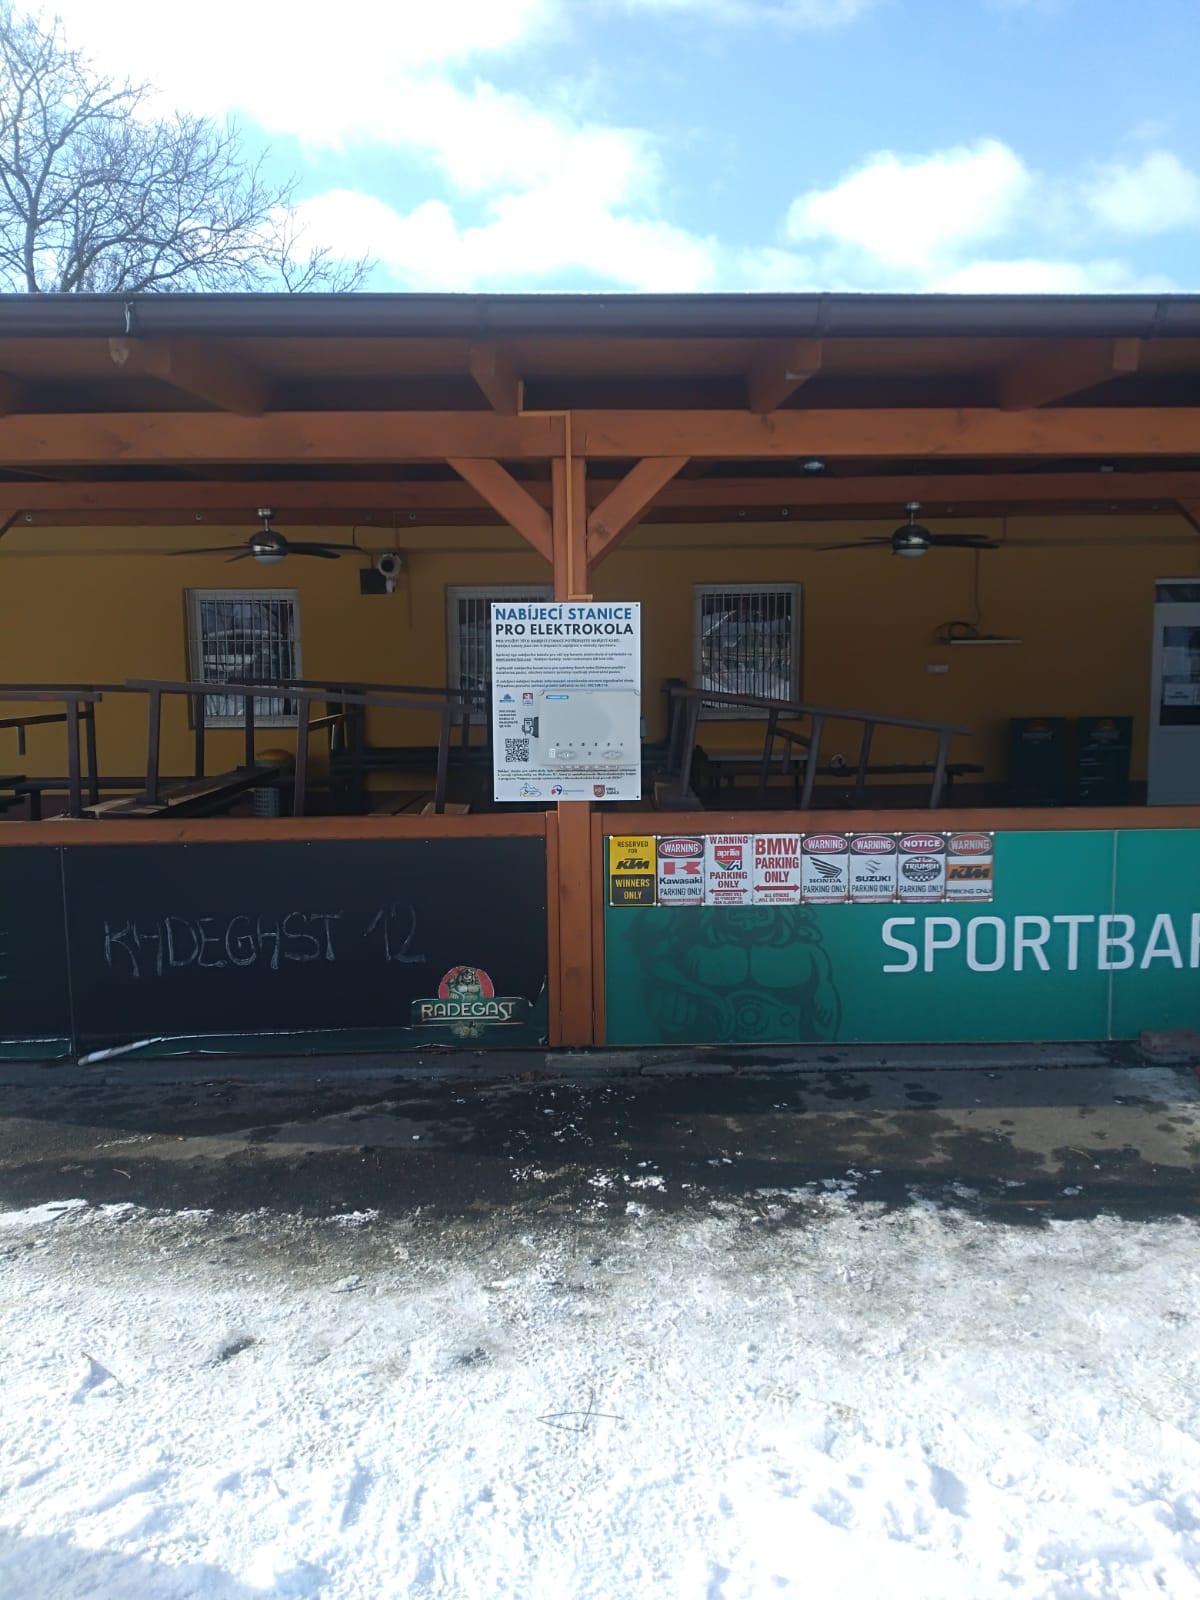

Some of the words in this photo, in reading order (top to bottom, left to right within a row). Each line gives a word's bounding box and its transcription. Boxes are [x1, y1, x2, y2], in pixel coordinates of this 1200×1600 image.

[495, 604, 563, 620] NABÍJECÍ
[568, 607, 632, 620] STANICE
[495, 623, 526, 635] PRO
[530, 623, 634, 635] ELEKTROKOLA
[709, 836, 749, 845] WARNING
[808, 839, 843, 849] WARNING
[856, 840, 891, 850] WARNING
[903, 840, 941, 848] NOTICE
[951, 839, 990, 850] WARNING
[664, 843, 699, 853] WARNING
[755, 837, 799, 856] BMW
[716, 848, 740, 858] aprilia
[616, 857, 650, 870] KTM
[755, 856, 800, 869] PARKING
[709, 871, 748, 880] PARKING
[764, 870, 790, 883] ONLY
[949, 865, 991, 879] KTM
[615, 878, 650, 888] WINNERS
[659, 876, 703, 885] Kawasaki
[717, 880, 740, 888] ONLY
[659, 887, 686, 896] PARKING
[687, 887, 703, 896] ONLY
[803, 884, 830, 893] PARKING
[831, 884, 847, 893] ONLY
[851, 884, 878, 893] PARKING
[879, 884, 896, 893] ONLY
[899, 884, 927, 893] PARKING
[927, 884, 943, 893] ONLY
[623, 890, 642, 900] ONLY
[363, 903, 428, 963] 12
[881, 912, 1200, 972] SPORTBA
[420, 1001, 516, 1022] RADEGAST
